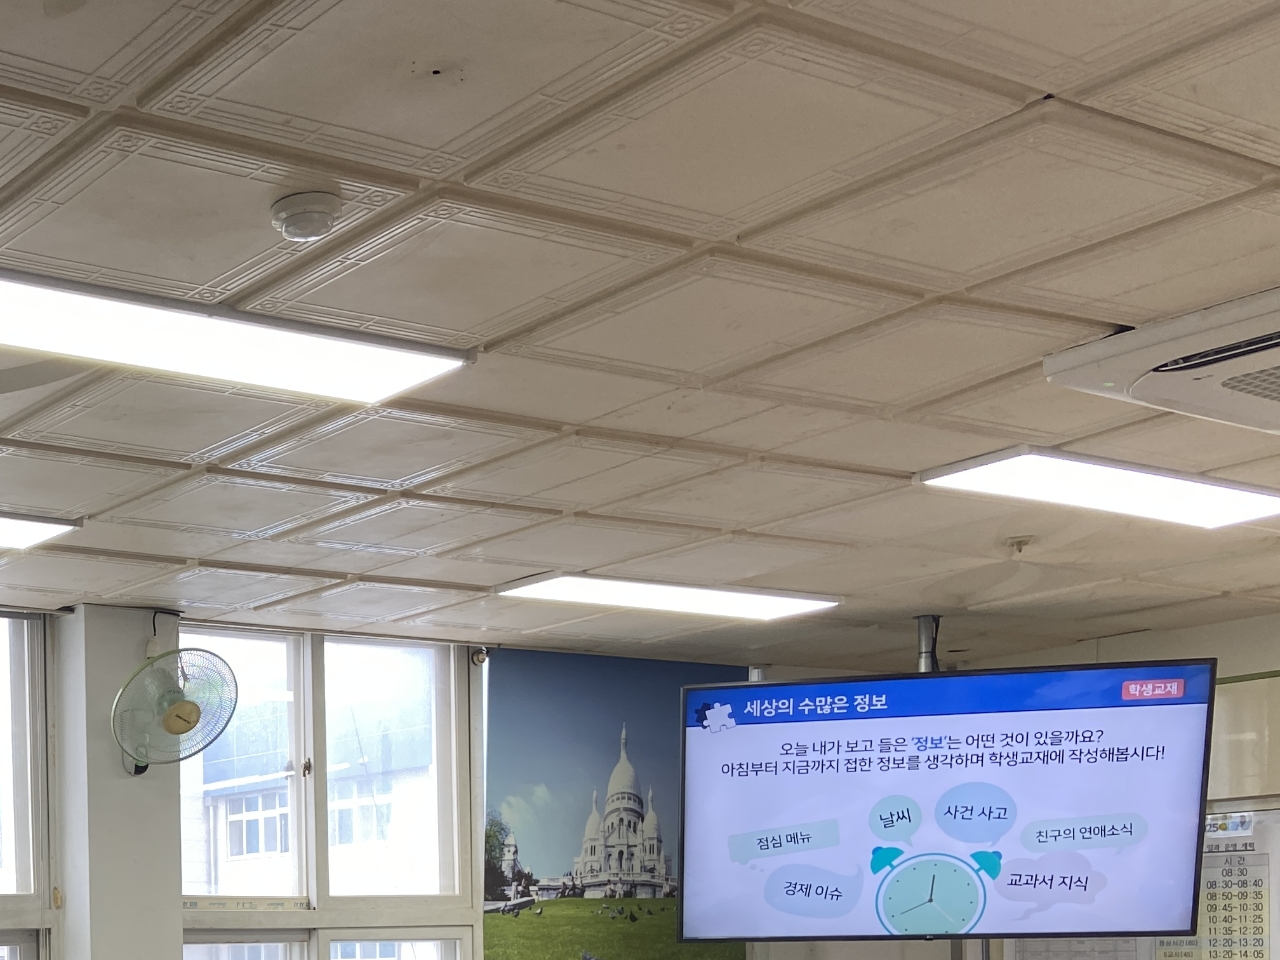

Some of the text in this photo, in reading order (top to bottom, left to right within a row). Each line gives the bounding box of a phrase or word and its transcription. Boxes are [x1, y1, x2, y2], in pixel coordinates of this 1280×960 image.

[1128, 681, 1178, 696] 학생교재
[743, 694, 888, 717] 세상의 수많은 정보
[779, 742, 809, 757] 오늘
[813, 740, 842, 755] 내가
[844, 739, 875, 753] 보고
[878, 737, 908, 753] 들은
[965, 732, 995, 750] 어떤
[999, 731, 1029, 748] 것이
[1033, 729, 1104, 747] 있을까요?
[721, 745, 1165, 777] 아침부터 지금까지 접한 정보를 생각하며 학생교재에 작성해봅시다!
[878, 807, 912, 828] 날씨
[943, 804, 1009, 821] 사건 사고
[756, 830, 813, 851] 점심 메뉴
[1035, 822, 1134, 843] 친구의 연애소식
[1006, 872, 1089, 891] 교과서 지식
[1221, 867, 1248, 877] 08:30
[783, 880, 843, 901] 경제 이슈
